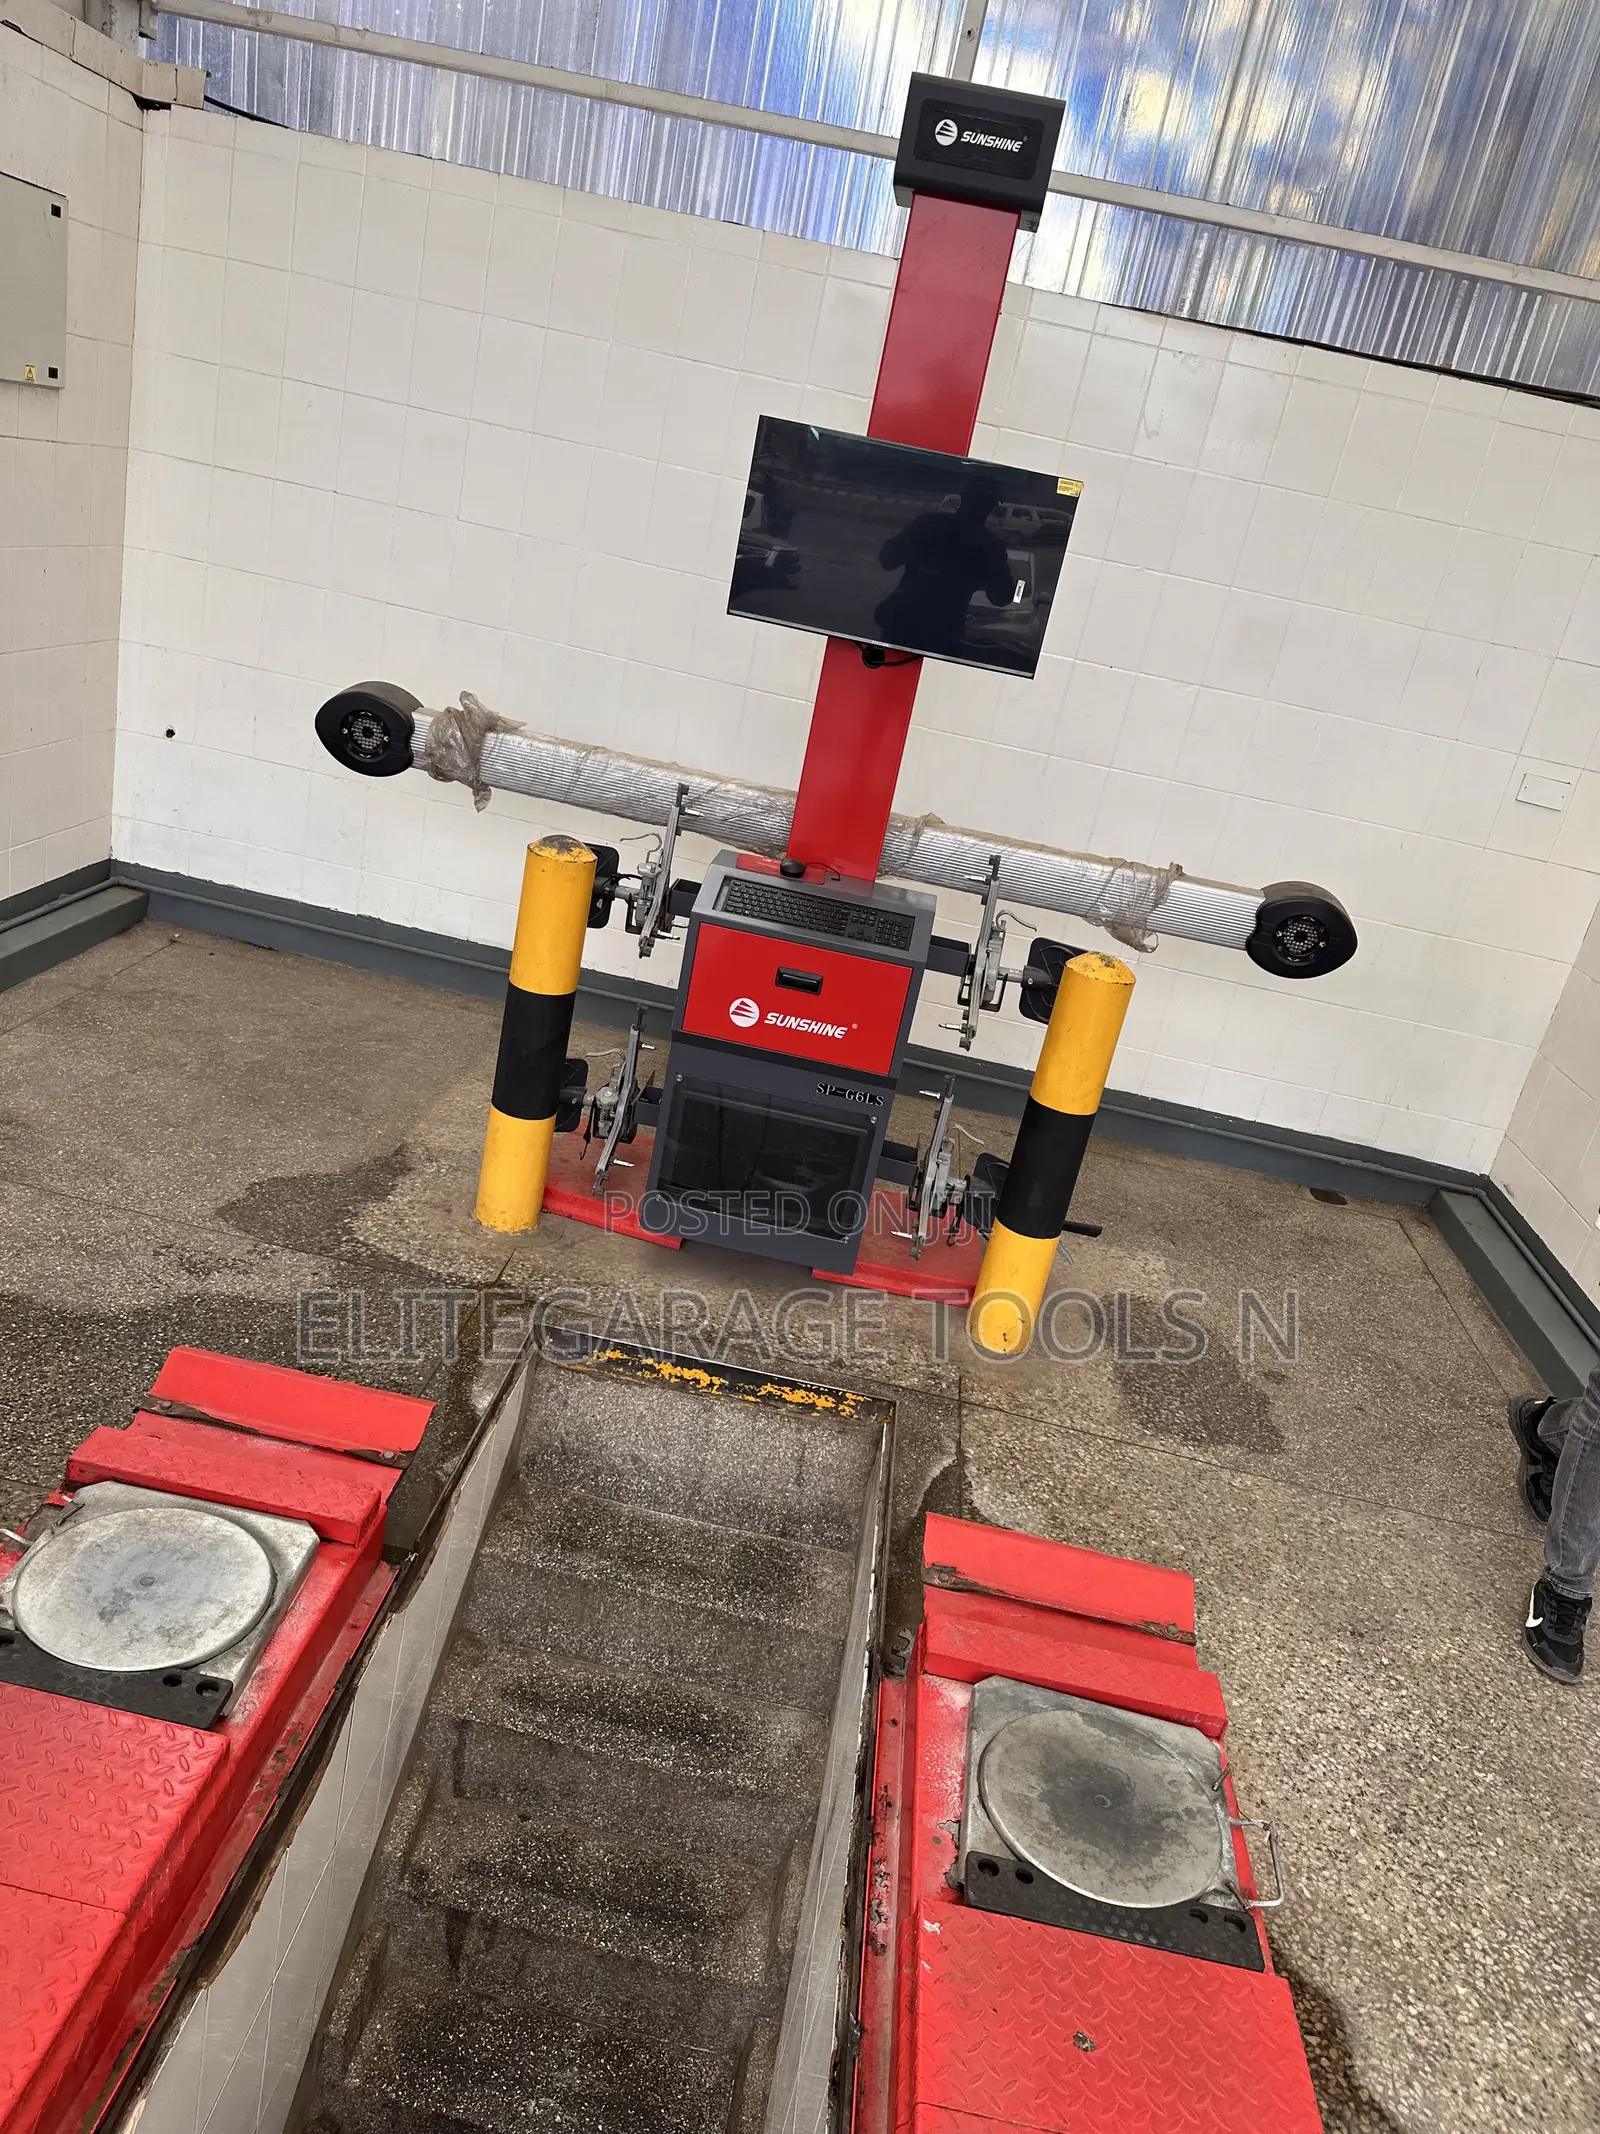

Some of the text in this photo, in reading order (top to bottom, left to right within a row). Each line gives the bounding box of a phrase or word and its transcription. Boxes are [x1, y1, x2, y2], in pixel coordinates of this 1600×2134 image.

[961, 131, 1023, 153] SUNSHINE
[764, 1012, 848, 1039] SUNSHINE
[815, 1082, 885, 1107] SP-G6LS
